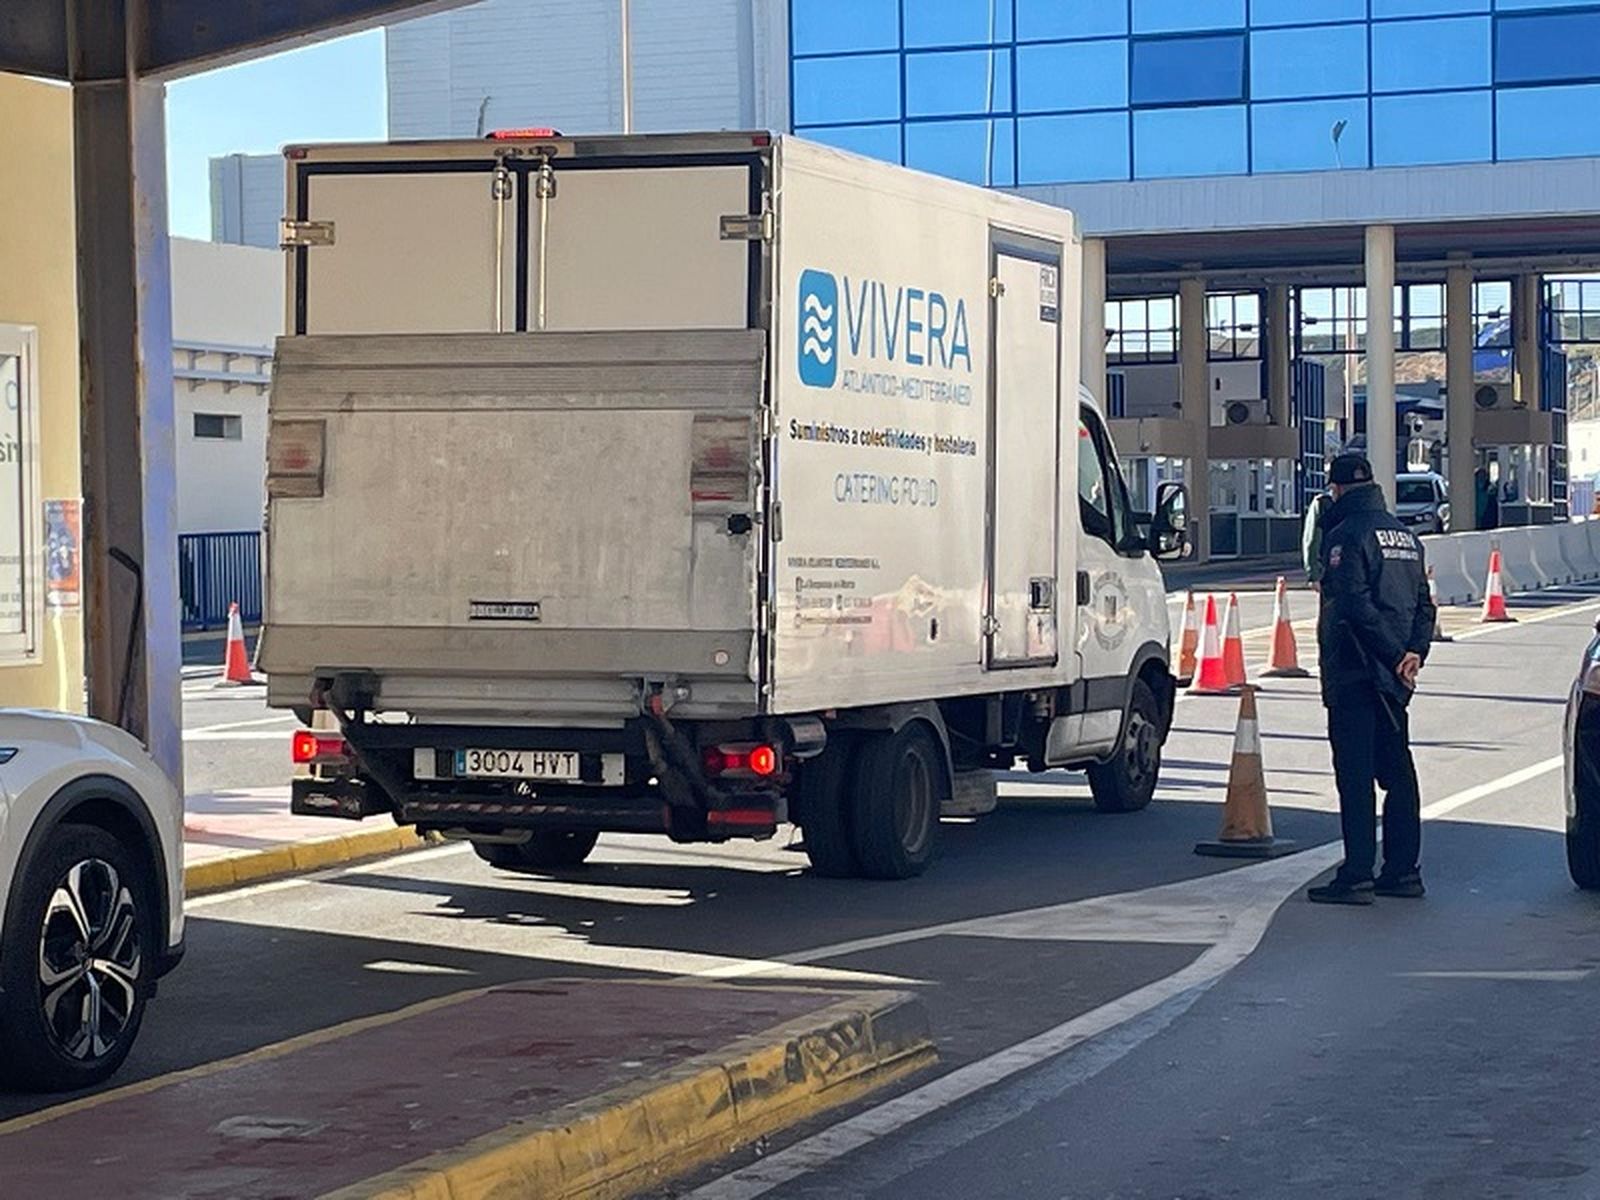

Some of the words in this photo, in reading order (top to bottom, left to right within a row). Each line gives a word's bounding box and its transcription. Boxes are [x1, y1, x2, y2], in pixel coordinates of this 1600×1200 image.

[843, 275, 972, 373] VIVERA
[789, 418, 850, 445] Suministros
[851, 429, 859, 445] a
[835, 473, 899, 505] CATERING
[468, 750, 524, 773] 3004
[532, 751, 575, 775] HVT
